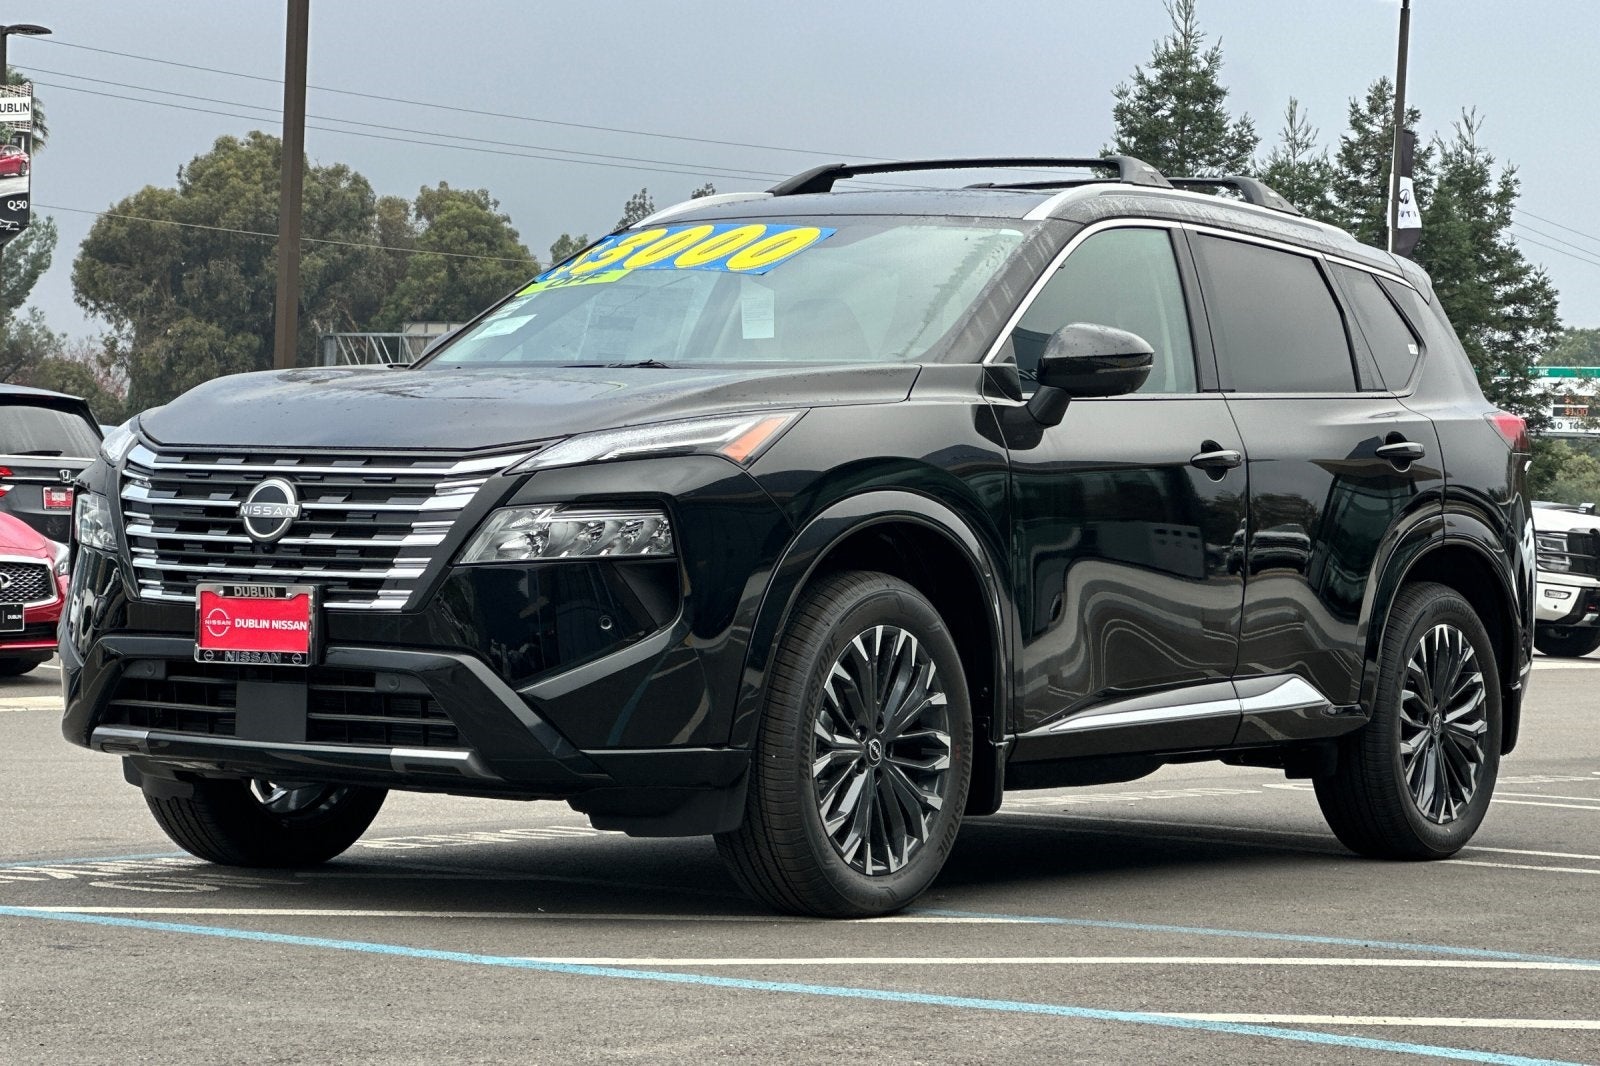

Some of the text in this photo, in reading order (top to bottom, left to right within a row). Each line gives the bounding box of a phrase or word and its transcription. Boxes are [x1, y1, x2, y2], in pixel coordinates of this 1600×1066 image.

[7, 200, 28, 211] Q50
[240, 505, 297, 516] NISSAN
[233, 586, 276, 598] DUBLIN
[234, 618, 307, 631] DUBLIN NISSAN
[224, 651, 281, 663] NISSAN
